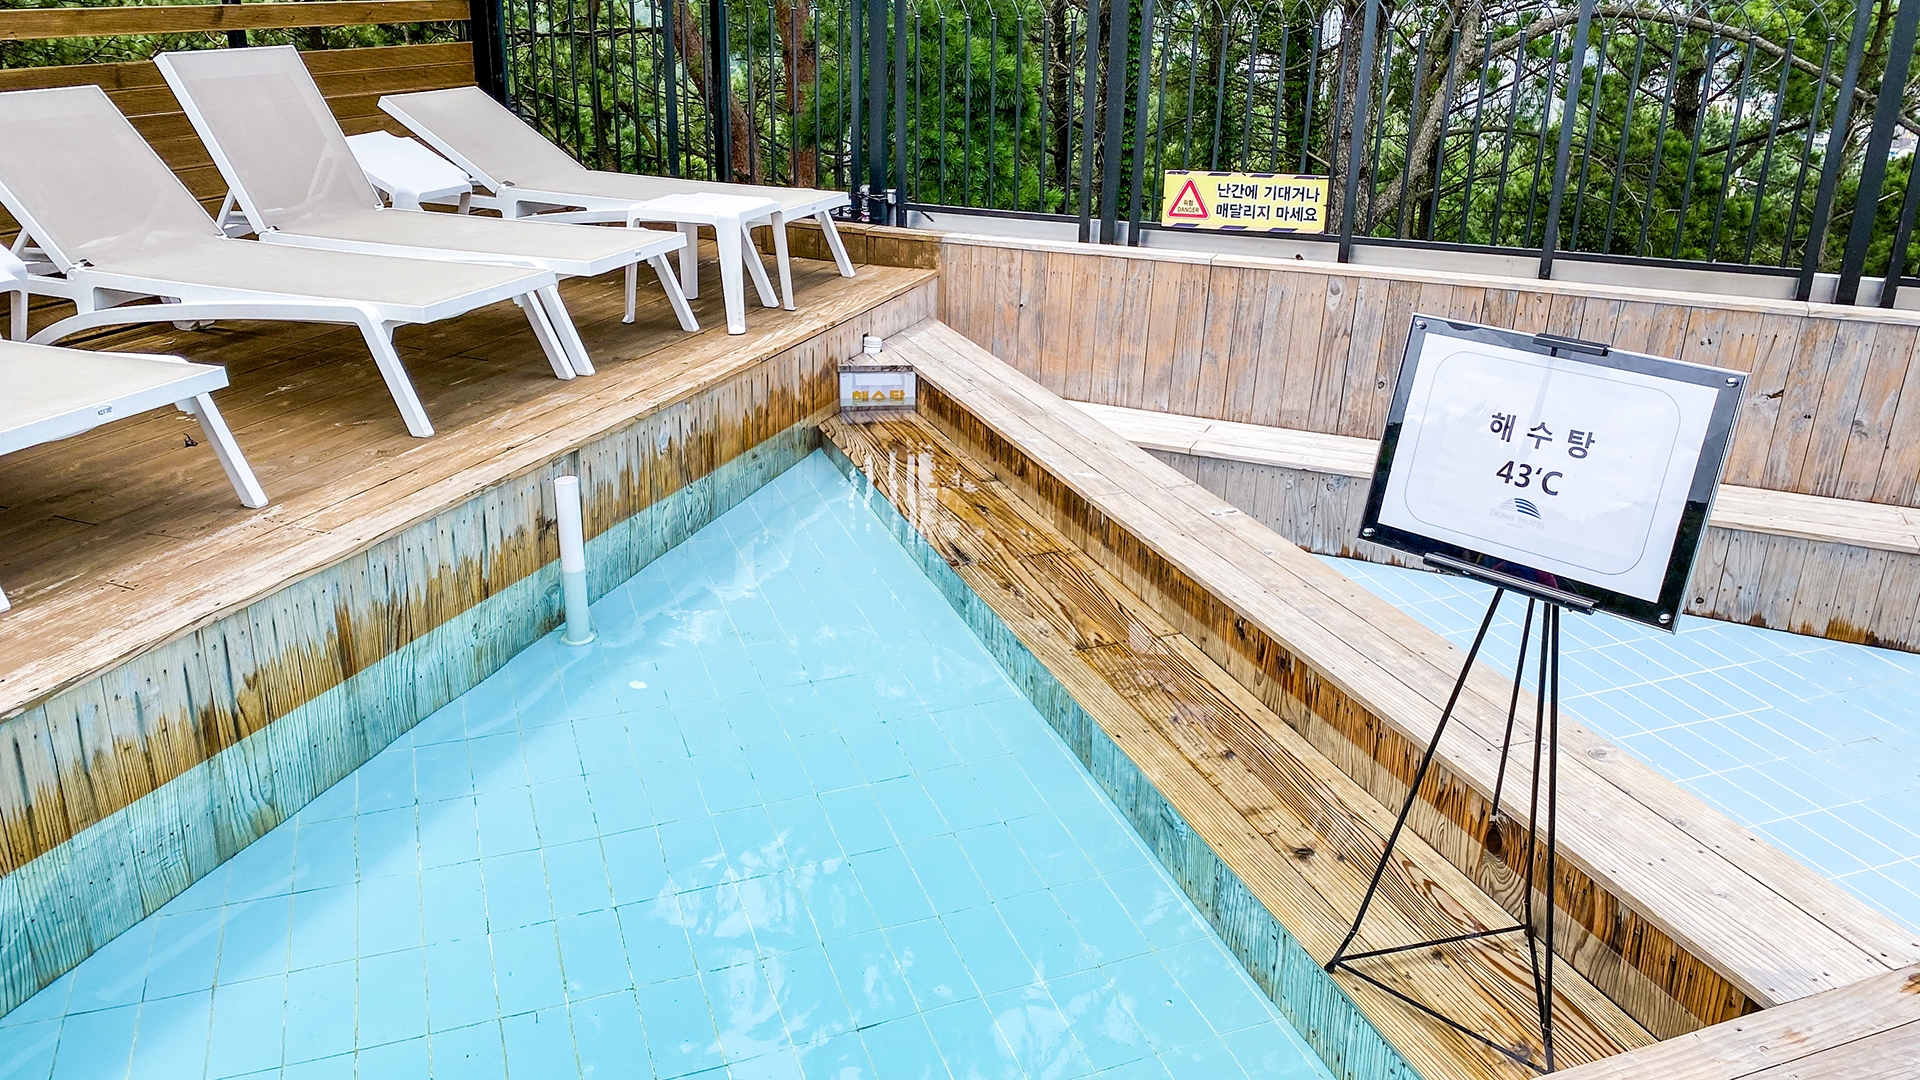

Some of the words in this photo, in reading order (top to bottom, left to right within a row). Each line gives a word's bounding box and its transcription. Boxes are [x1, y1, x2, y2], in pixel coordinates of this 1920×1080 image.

[1217, 183, 1258, 200] 난간에
[1263, 186, 1321, 203] 기대거나
[1216, 202, 1271, 221] 매달리지
[1275, 205, 1318, 222] 마세요
